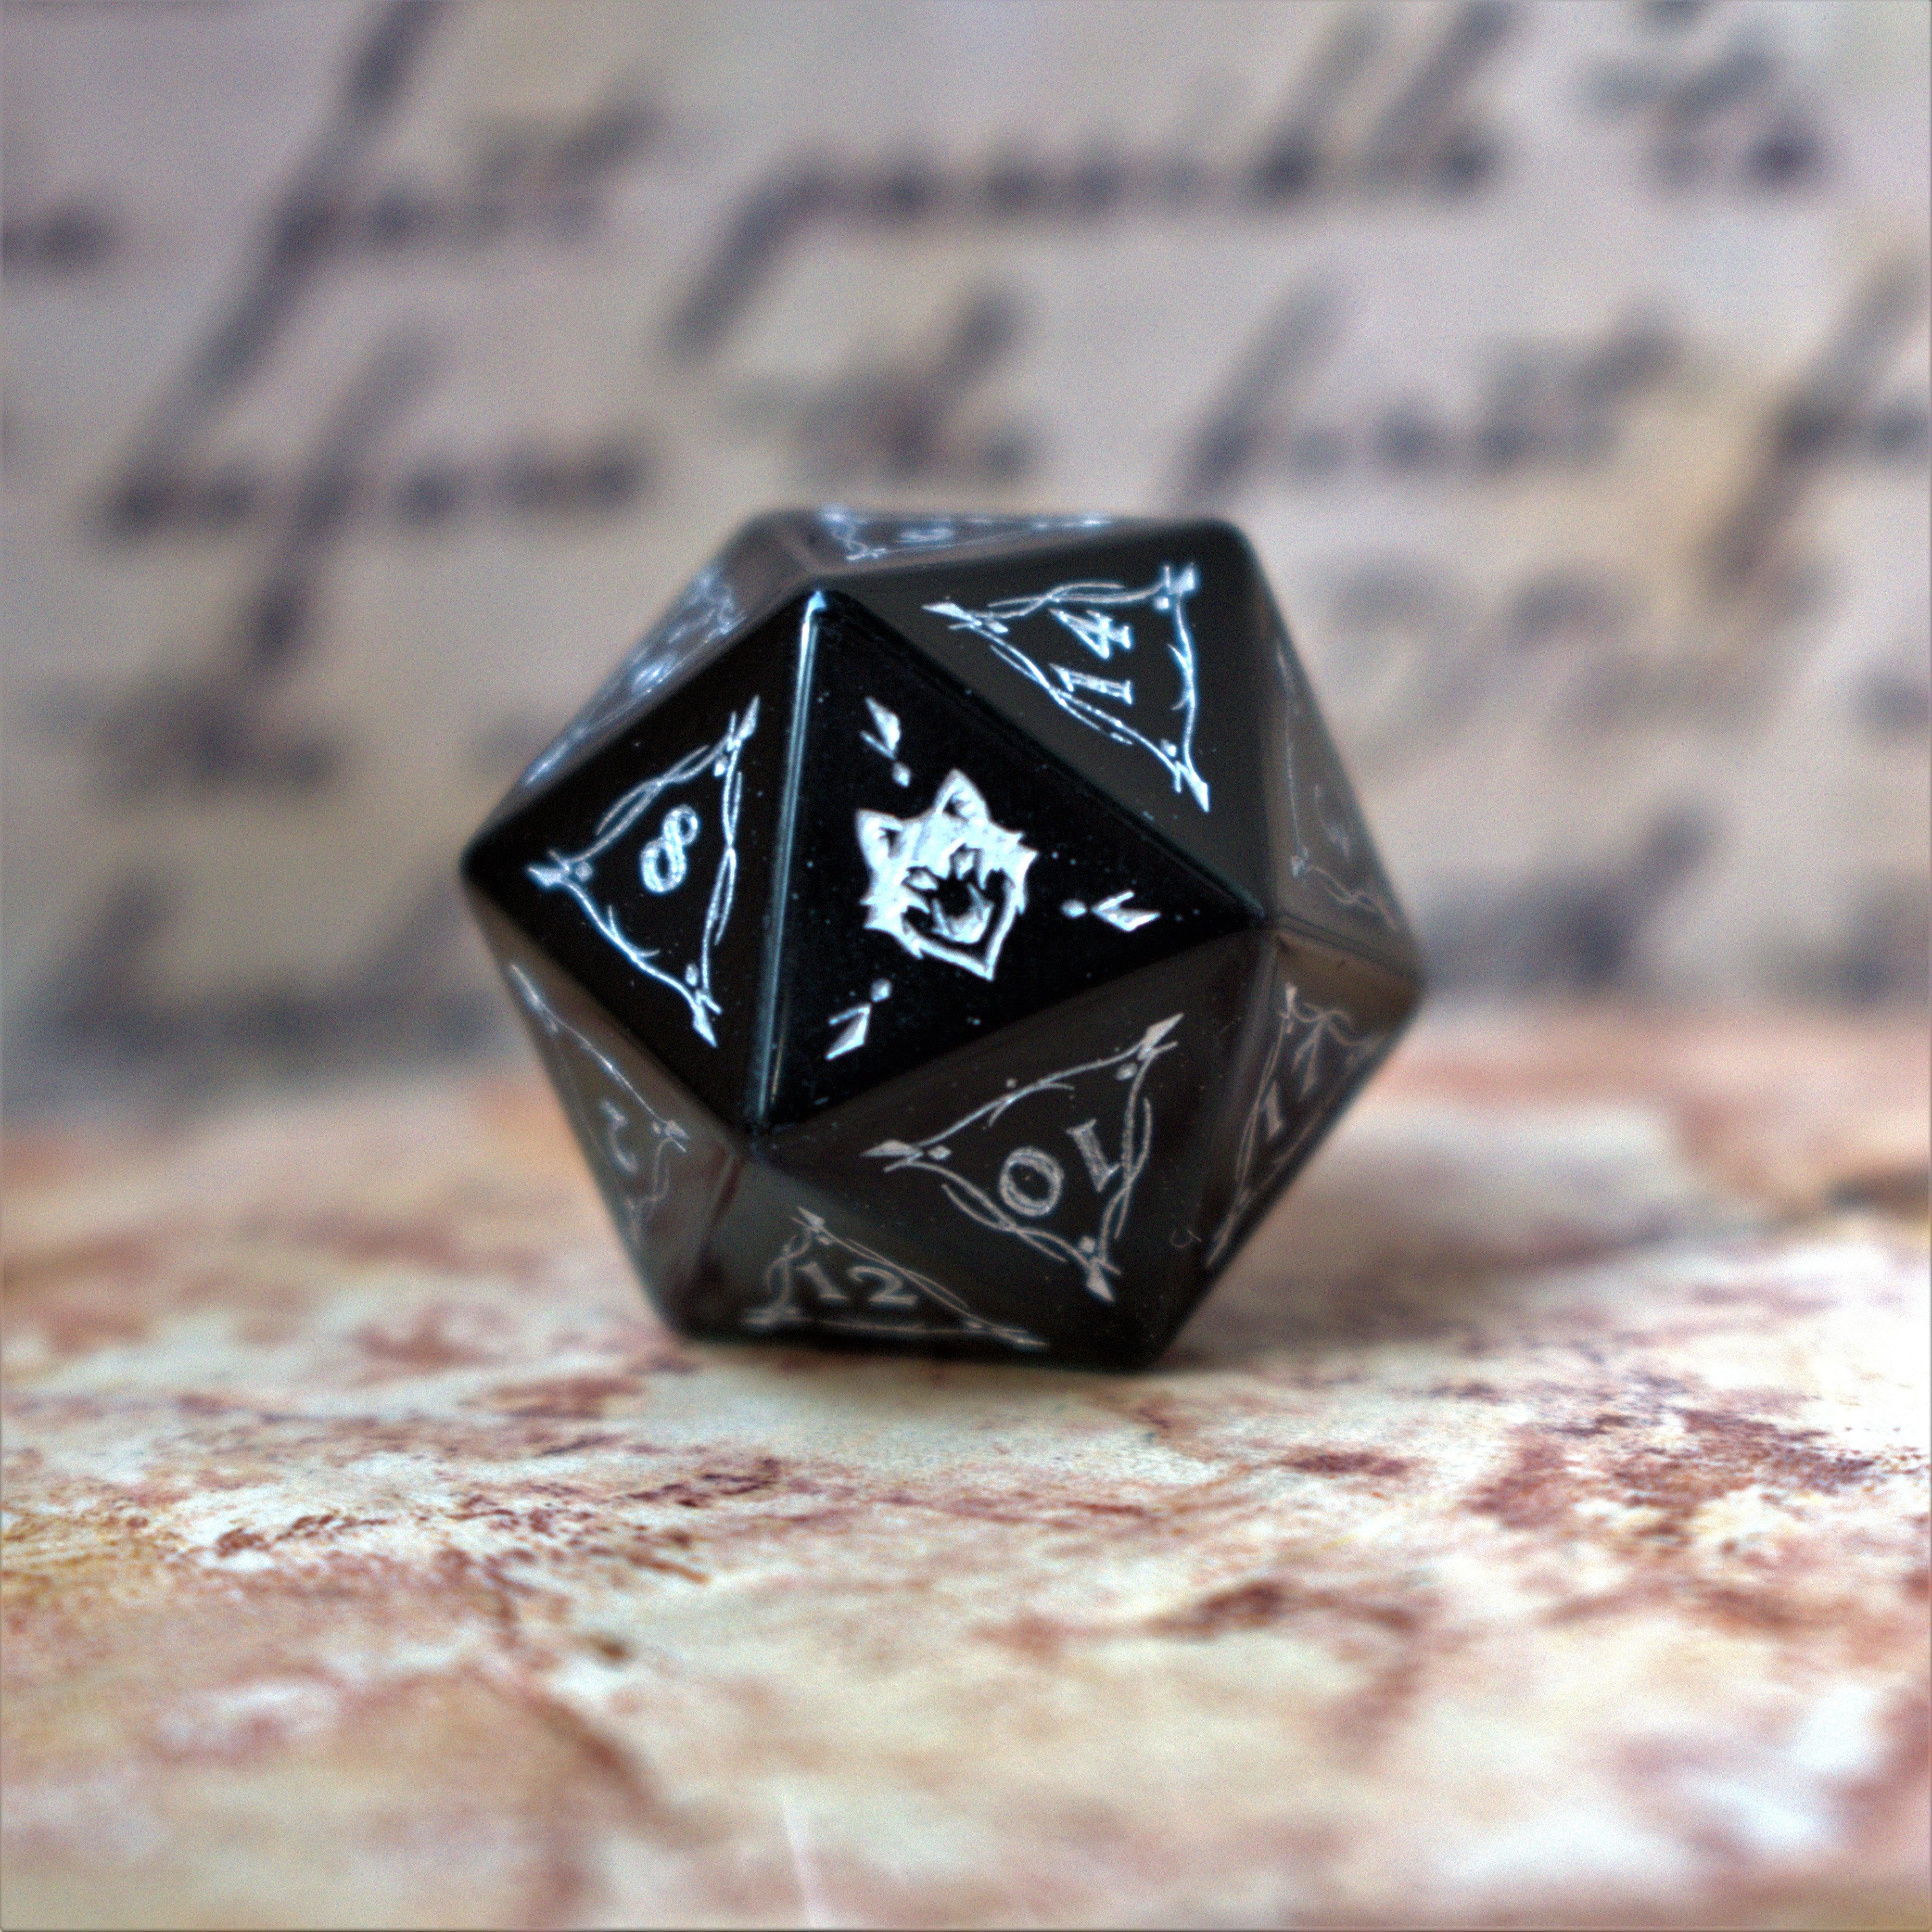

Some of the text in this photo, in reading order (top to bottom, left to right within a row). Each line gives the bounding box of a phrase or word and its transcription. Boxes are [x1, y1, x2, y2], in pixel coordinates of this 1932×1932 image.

[1049, 608, 1132, 705] 14
[640, 803, 699, 893] 8
[998, 1117, 1121, 1217] 10
[795, 1260, 916, 1307] 12
